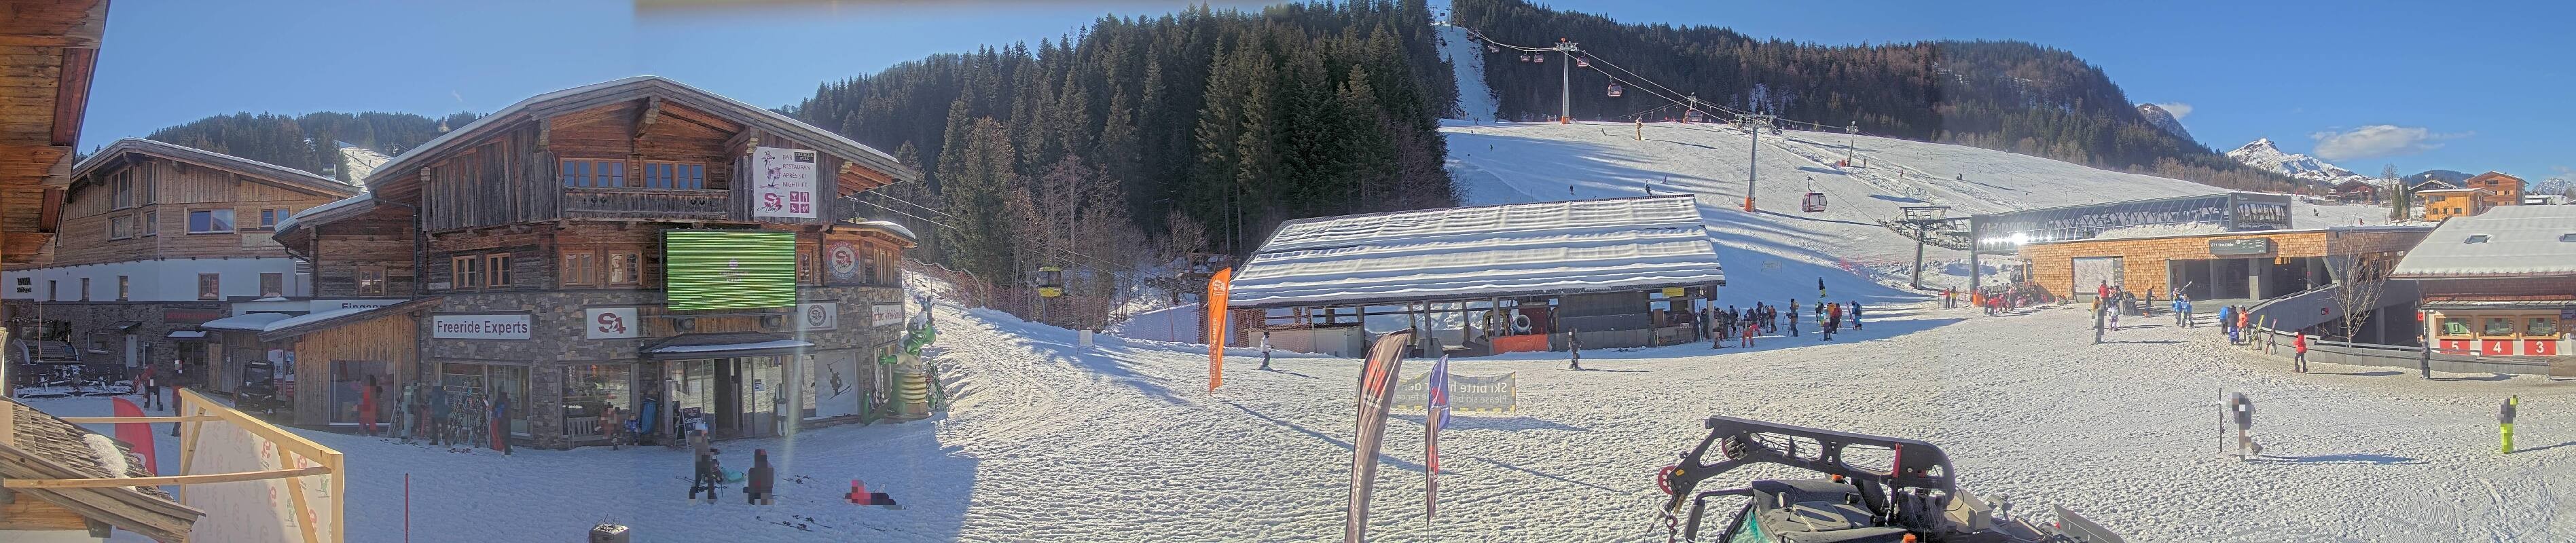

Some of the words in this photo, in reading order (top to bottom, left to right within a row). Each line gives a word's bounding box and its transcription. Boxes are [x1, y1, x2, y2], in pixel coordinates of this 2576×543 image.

[437, 320, 480, 333] Freeride
[484, 320, 528, 335] Experts
[2493, 341, 2501, 353] 4
[2536, 341, 2544, 353] 3
